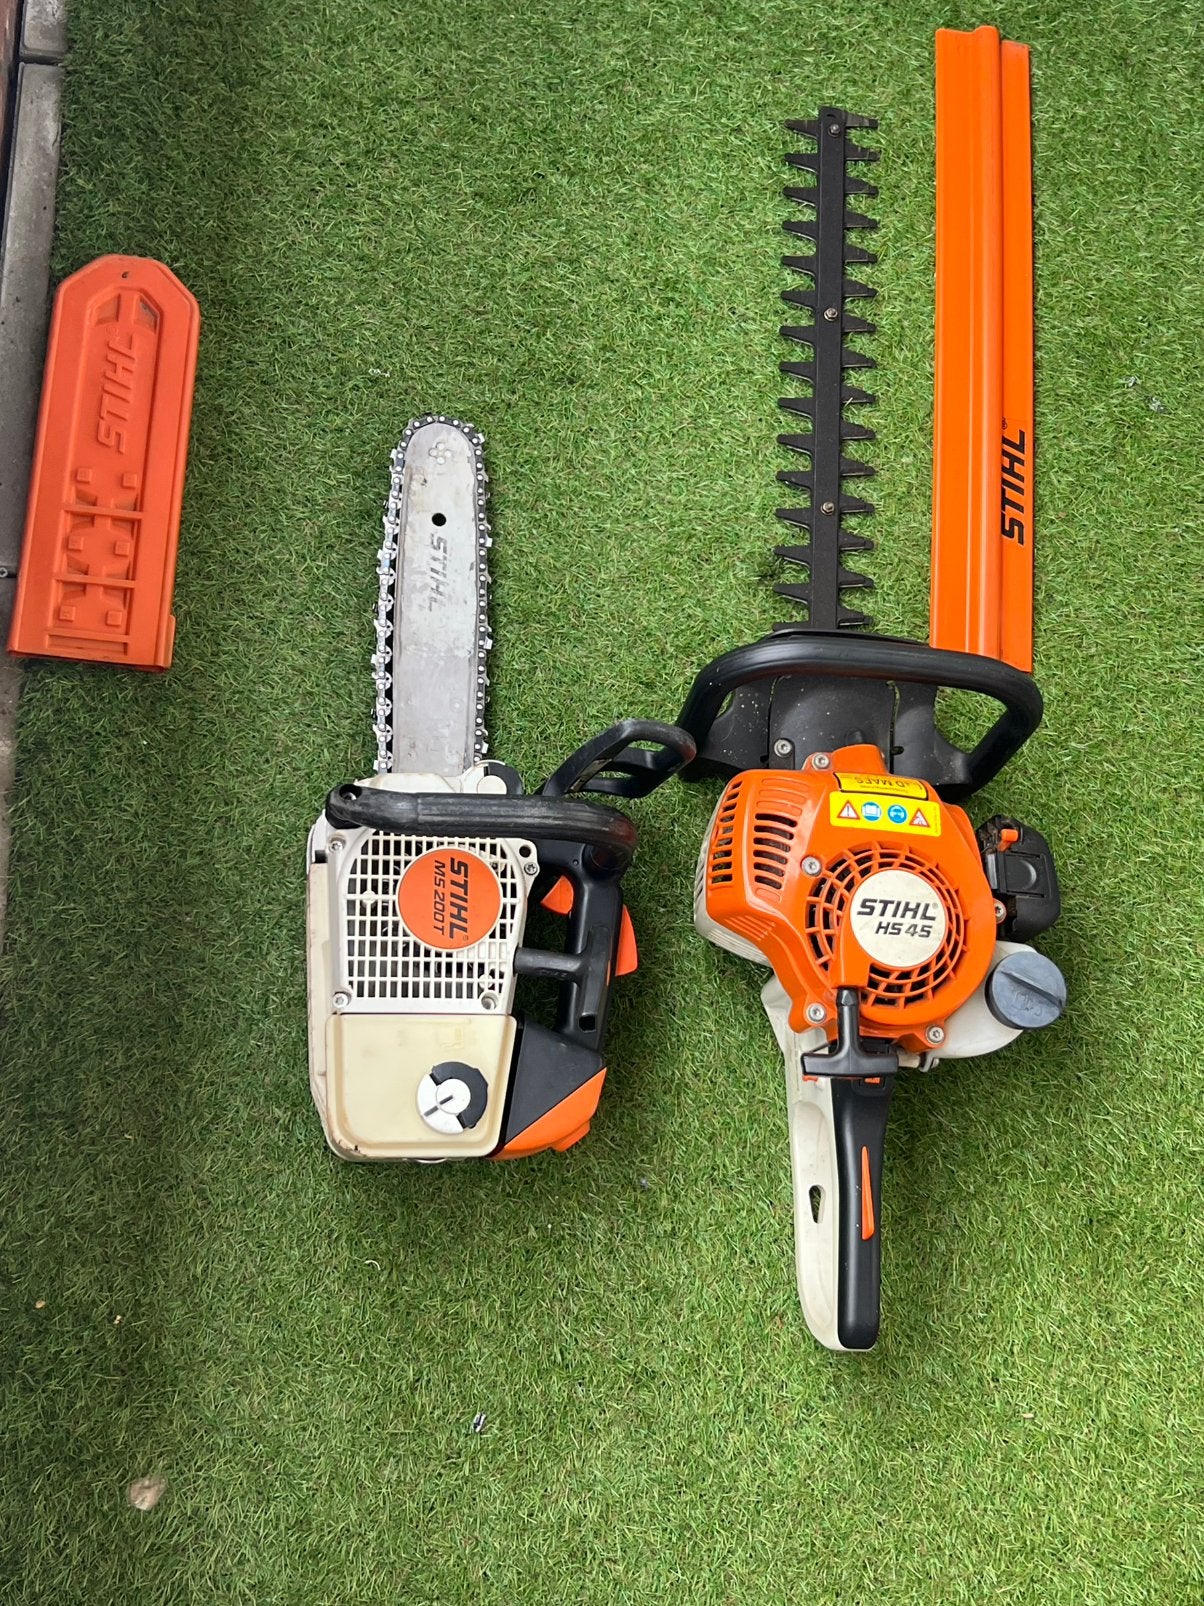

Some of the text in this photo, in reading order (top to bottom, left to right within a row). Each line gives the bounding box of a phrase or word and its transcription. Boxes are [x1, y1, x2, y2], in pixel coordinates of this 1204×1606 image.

[97, 333, 136, 455] STIHL
[1001, 429, 1025, 545] STIHL
[429, 534, 447, 612] STIHL
[449, 857, 469, 939] STIHL
[857, 898, 936, 921] STIHL
[875, 921, 933, 938] HS 45
